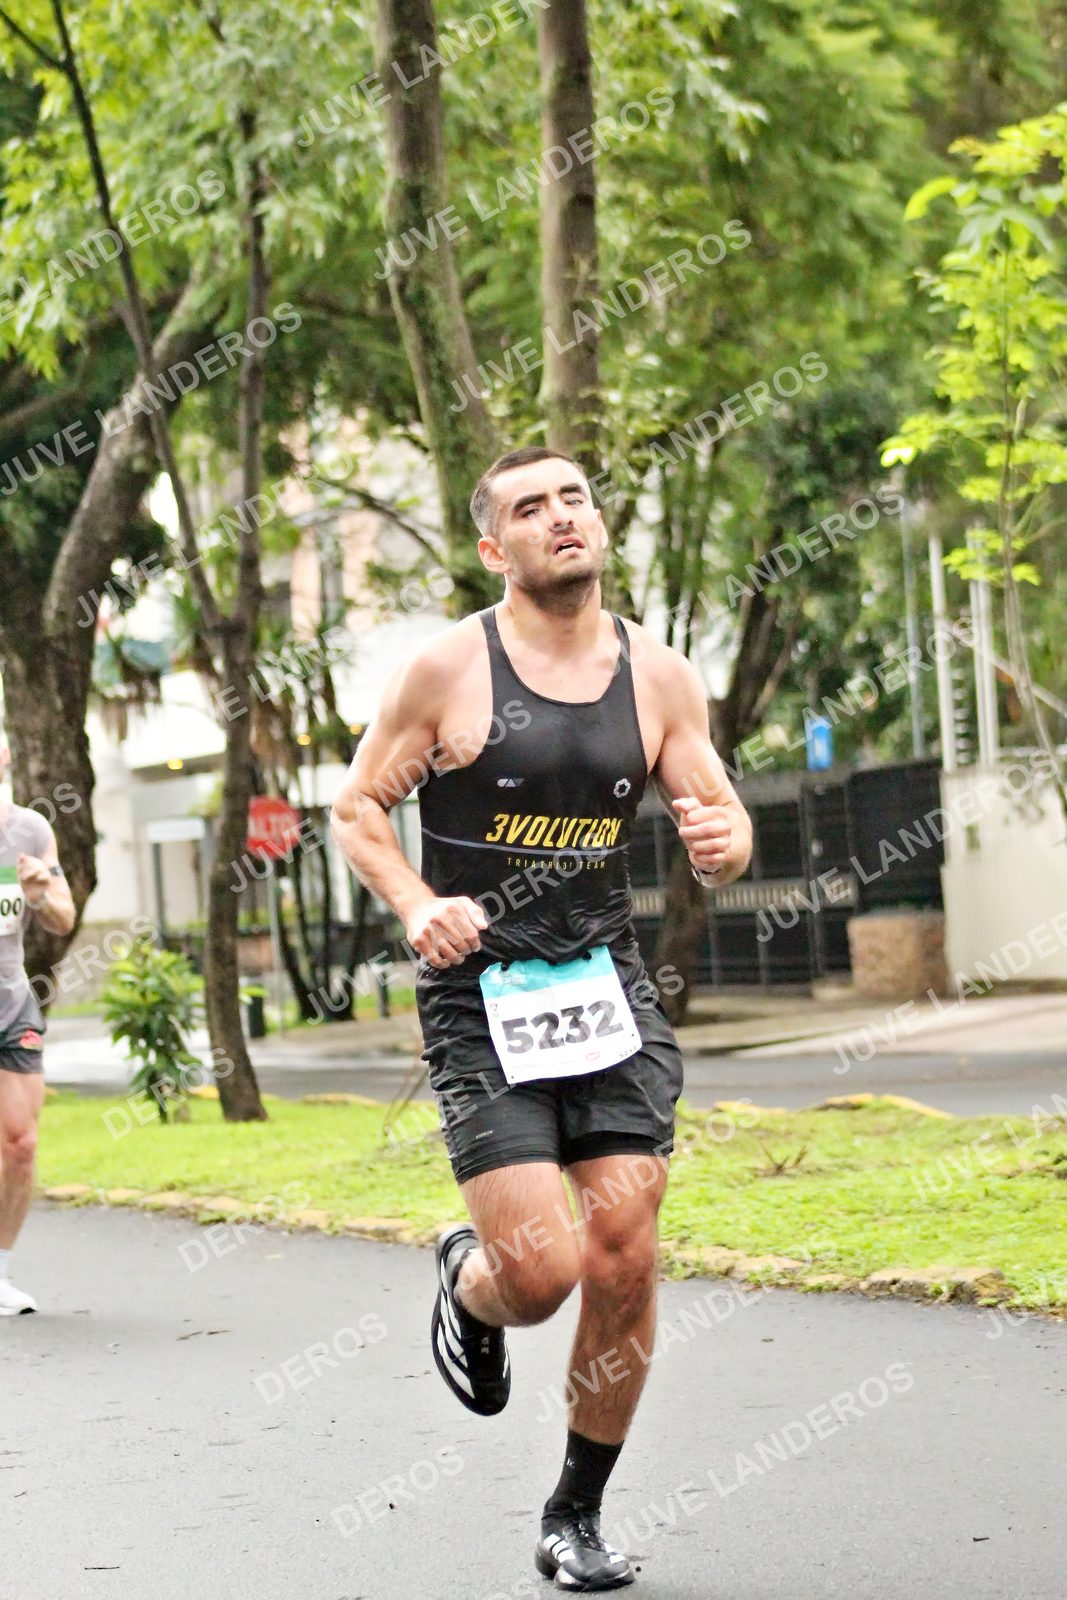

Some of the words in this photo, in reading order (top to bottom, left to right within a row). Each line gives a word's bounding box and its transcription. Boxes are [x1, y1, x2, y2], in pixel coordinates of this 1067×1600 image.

[485, 813, 623, 849] 3VOLUTION
[579, 861, 606, 870] TEAM
[502, 1000, 624, 1054] 5232
